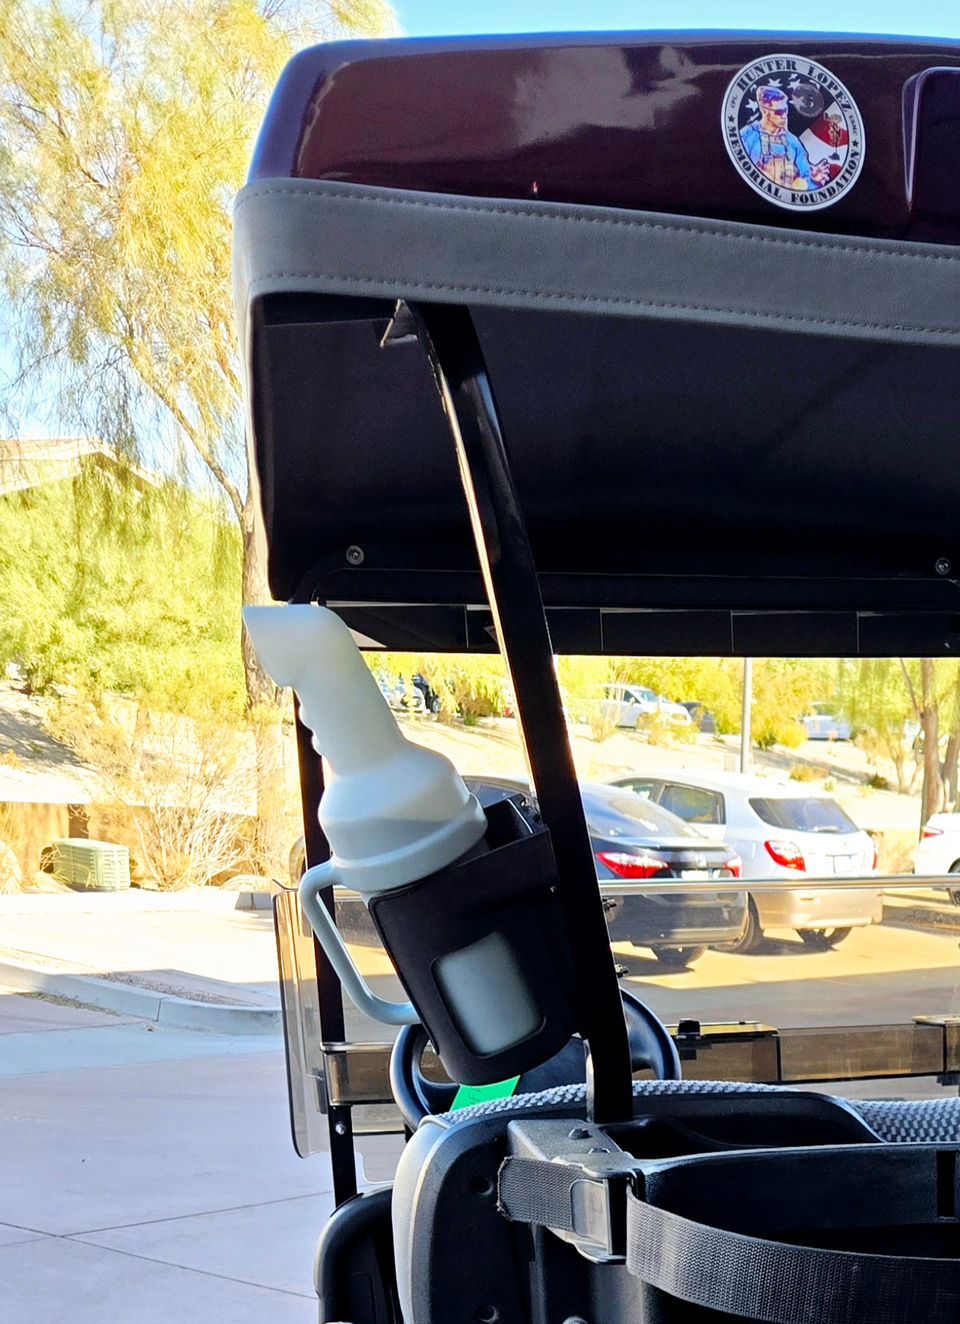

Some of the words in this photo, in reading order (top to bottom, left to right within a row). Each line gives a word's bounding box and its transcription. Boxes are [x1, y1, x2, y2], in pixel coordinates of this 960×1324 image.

[737, 59, 798, 92] HUNTER
[807, 66, 852, 112] LOPEZ
[728, 125, 782, 199] MEMORIAL
[791, 151, 860, 204] FOUNDATION
